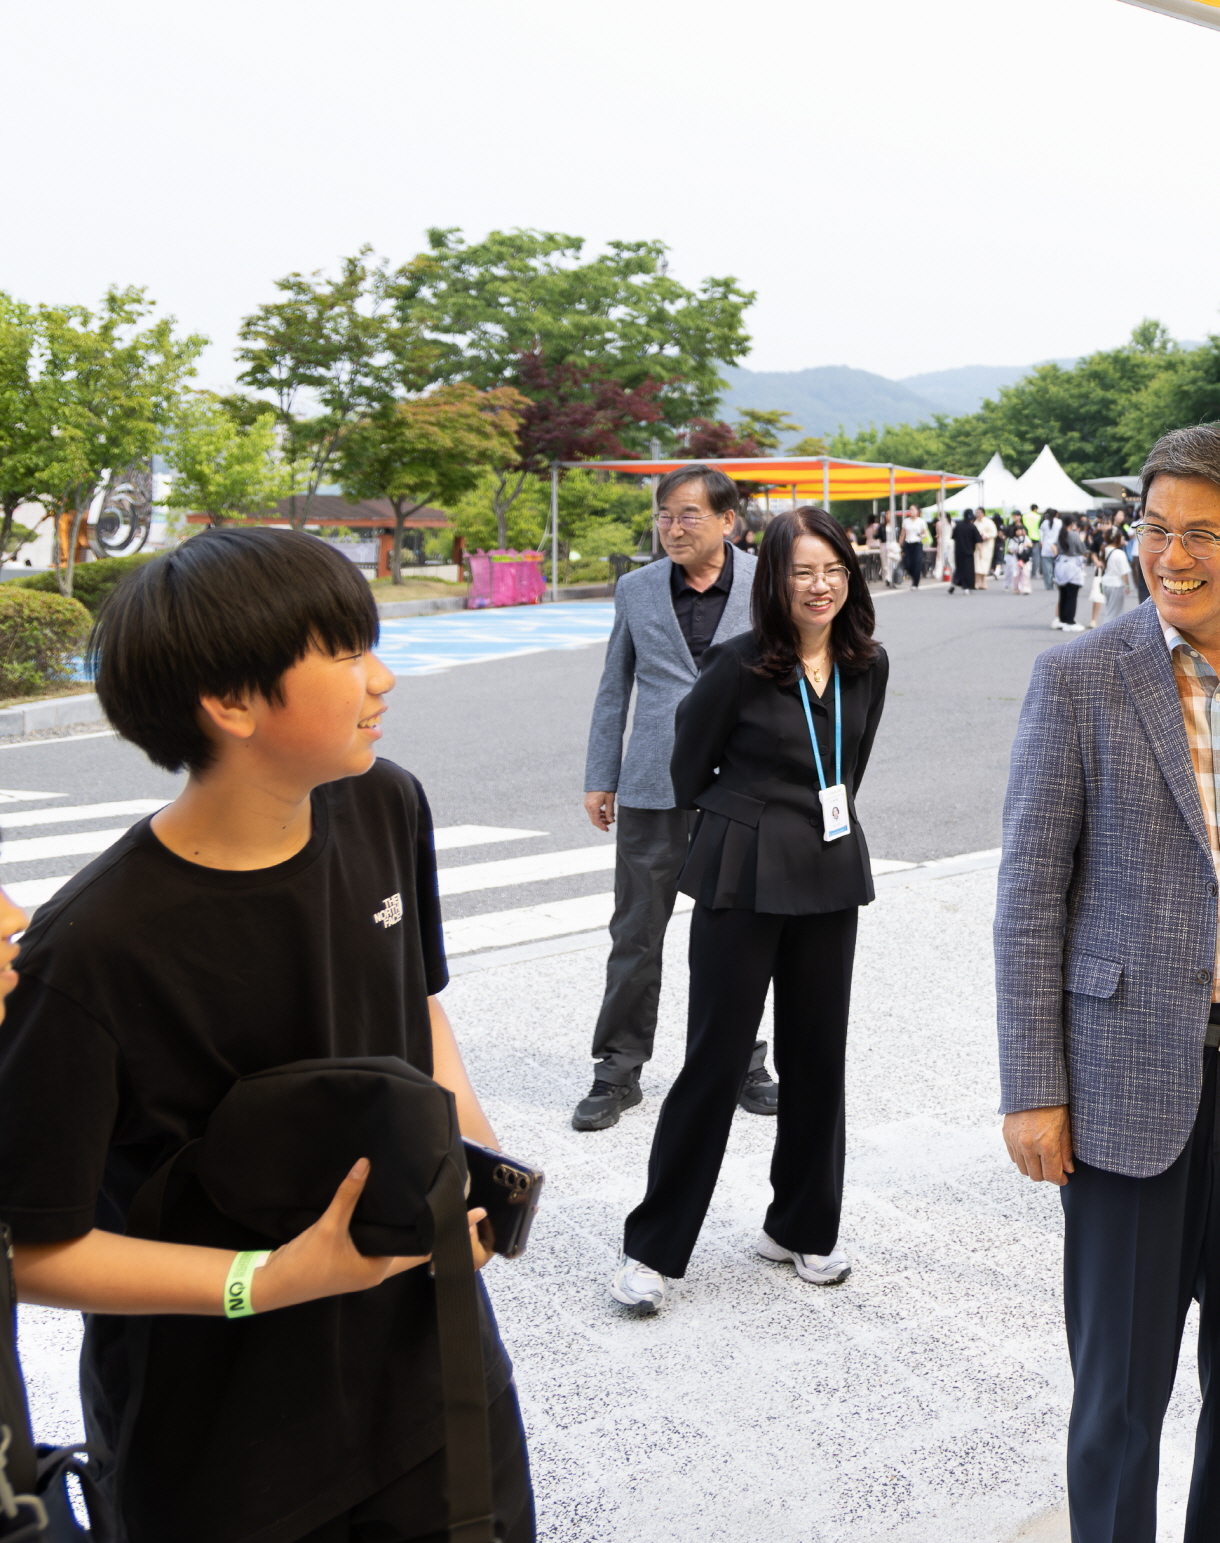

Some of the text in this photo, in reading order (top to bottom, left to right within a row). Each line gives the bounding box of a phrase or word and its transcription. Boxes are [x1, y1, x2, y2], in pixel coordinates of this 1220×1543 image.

[382, 893, 399, 909] THE
[373, 903, 402, 924] NORTH
[384, 913, 402, 929] FACE
[229, 1281, 246, 1312] ON
